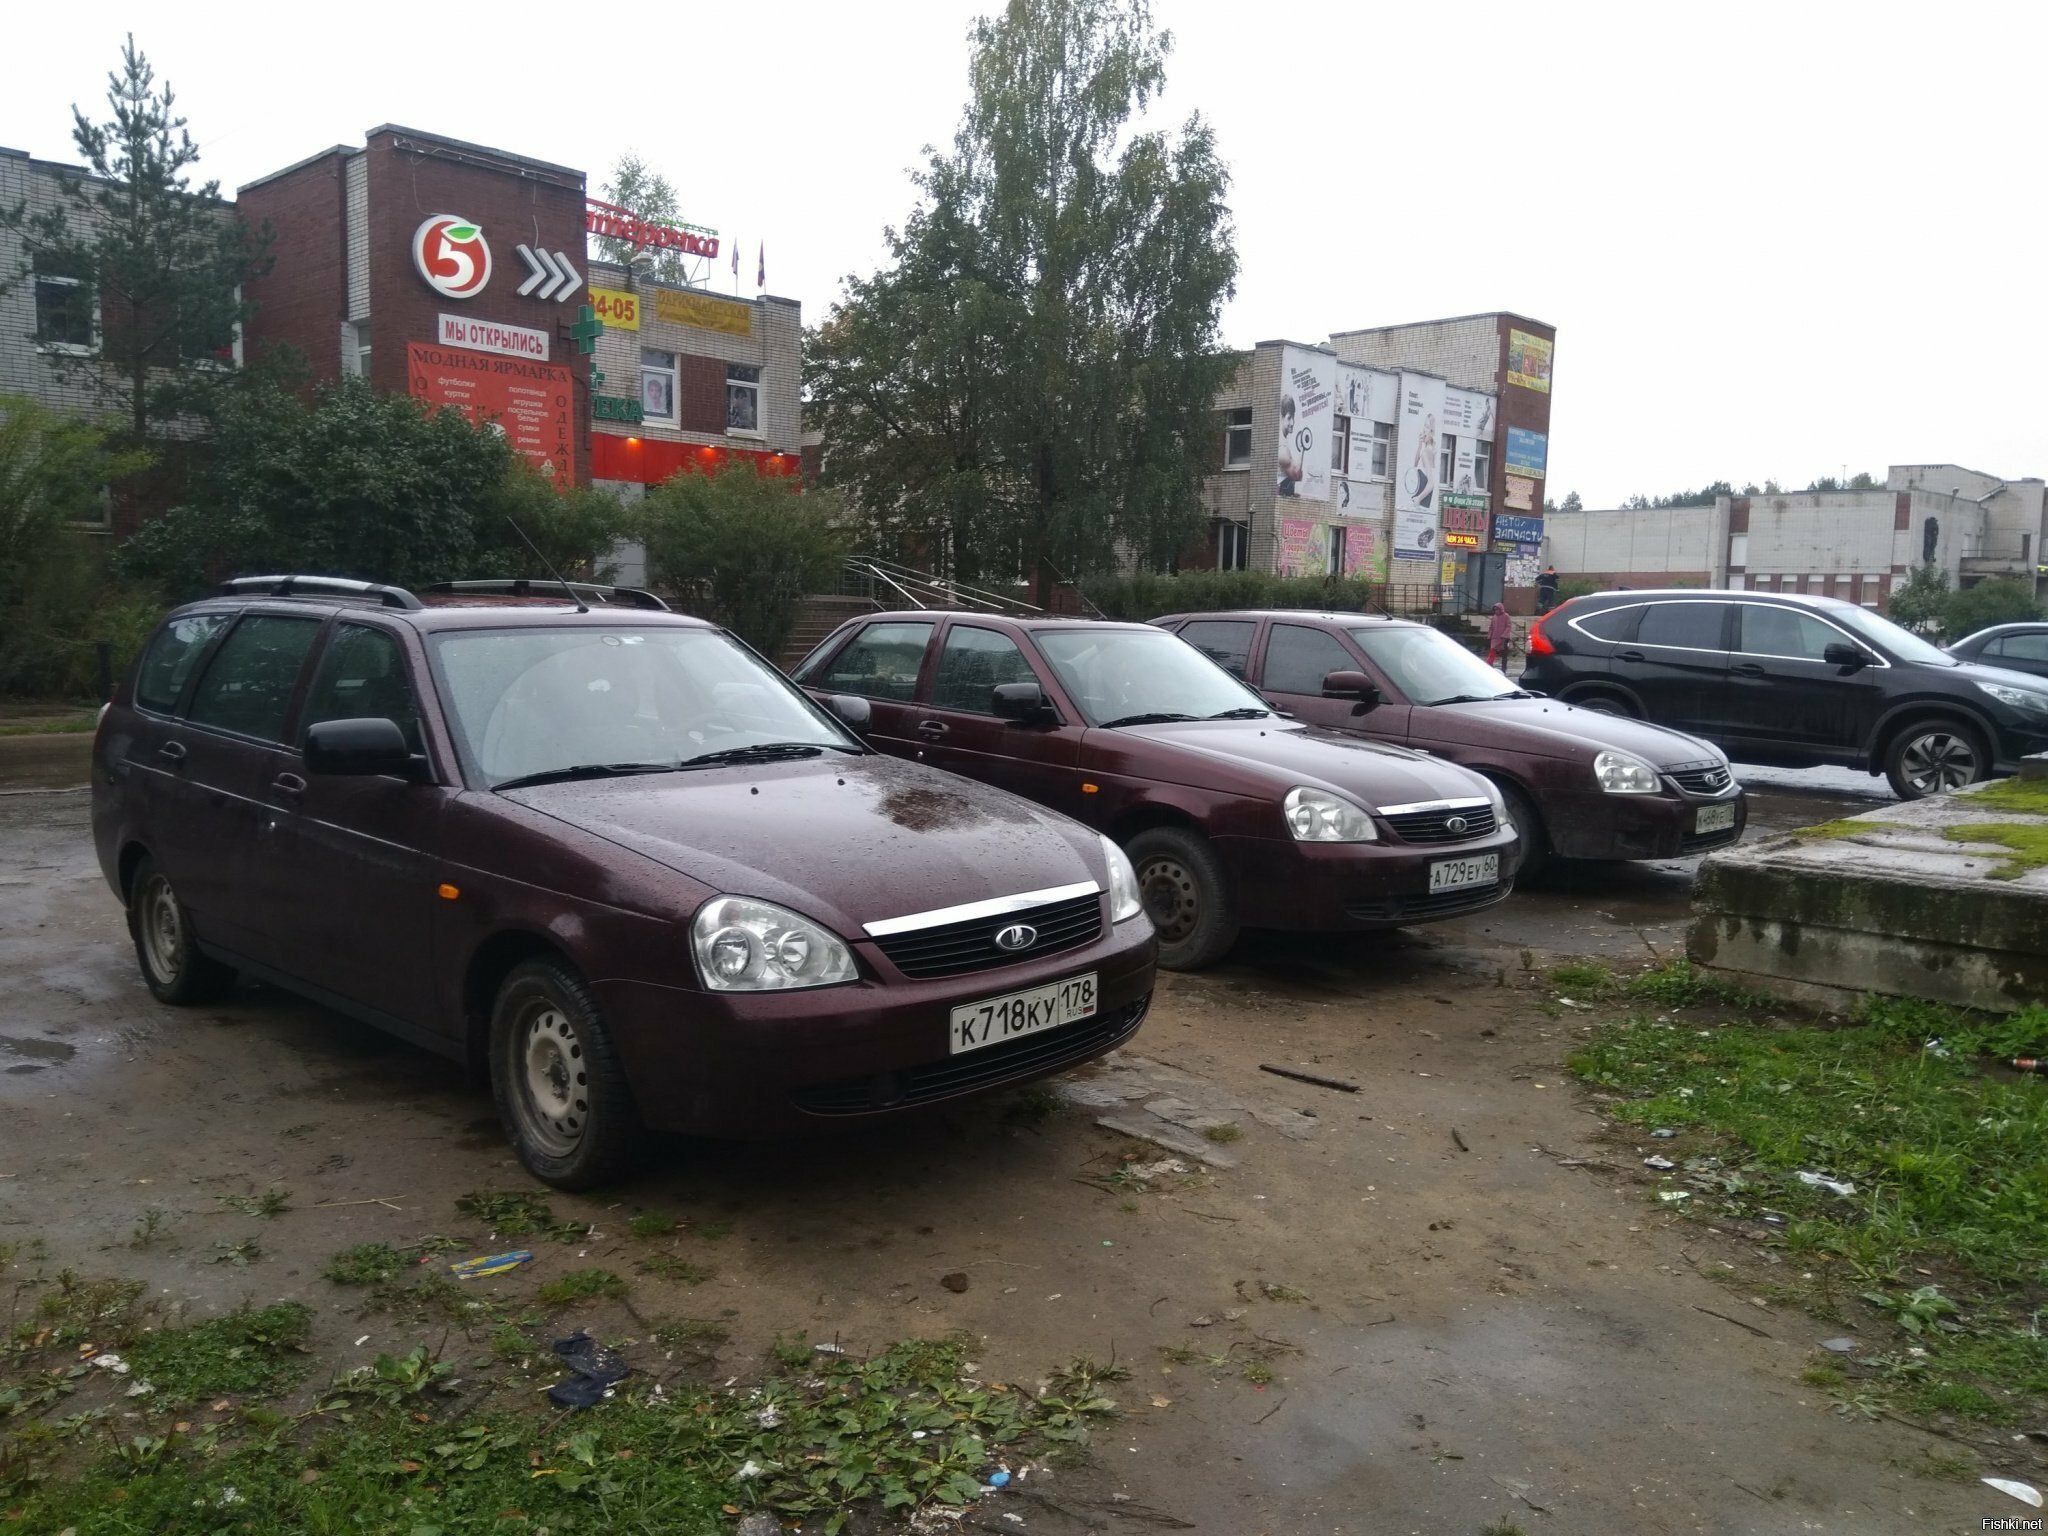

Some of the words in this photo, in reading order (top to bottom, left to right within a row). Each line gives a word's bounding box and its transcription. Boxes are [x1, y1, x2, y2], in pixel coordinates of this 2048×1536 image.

[445, 320, 466, 342] МЫ
[470, 324, 543, 355] ОТКРЫЛИСЬ
[413, 348, 490, 373] МОДНАЯ
[493, 362, 568, 383] ЯРМАРКА
[438, 376, 476, 389] футболки
[444, 390, 470, 400] куртки
[592, 396, 645, 421] ЕКА
[1443, 507, 1489, 531] ЦВЕТЫ
[1495, 528, 1543, 542] ЗАПЧАСТИ
[1061, 979, 1092, 1009] 178
[1066, 1006, 1083, 1018] RUS
